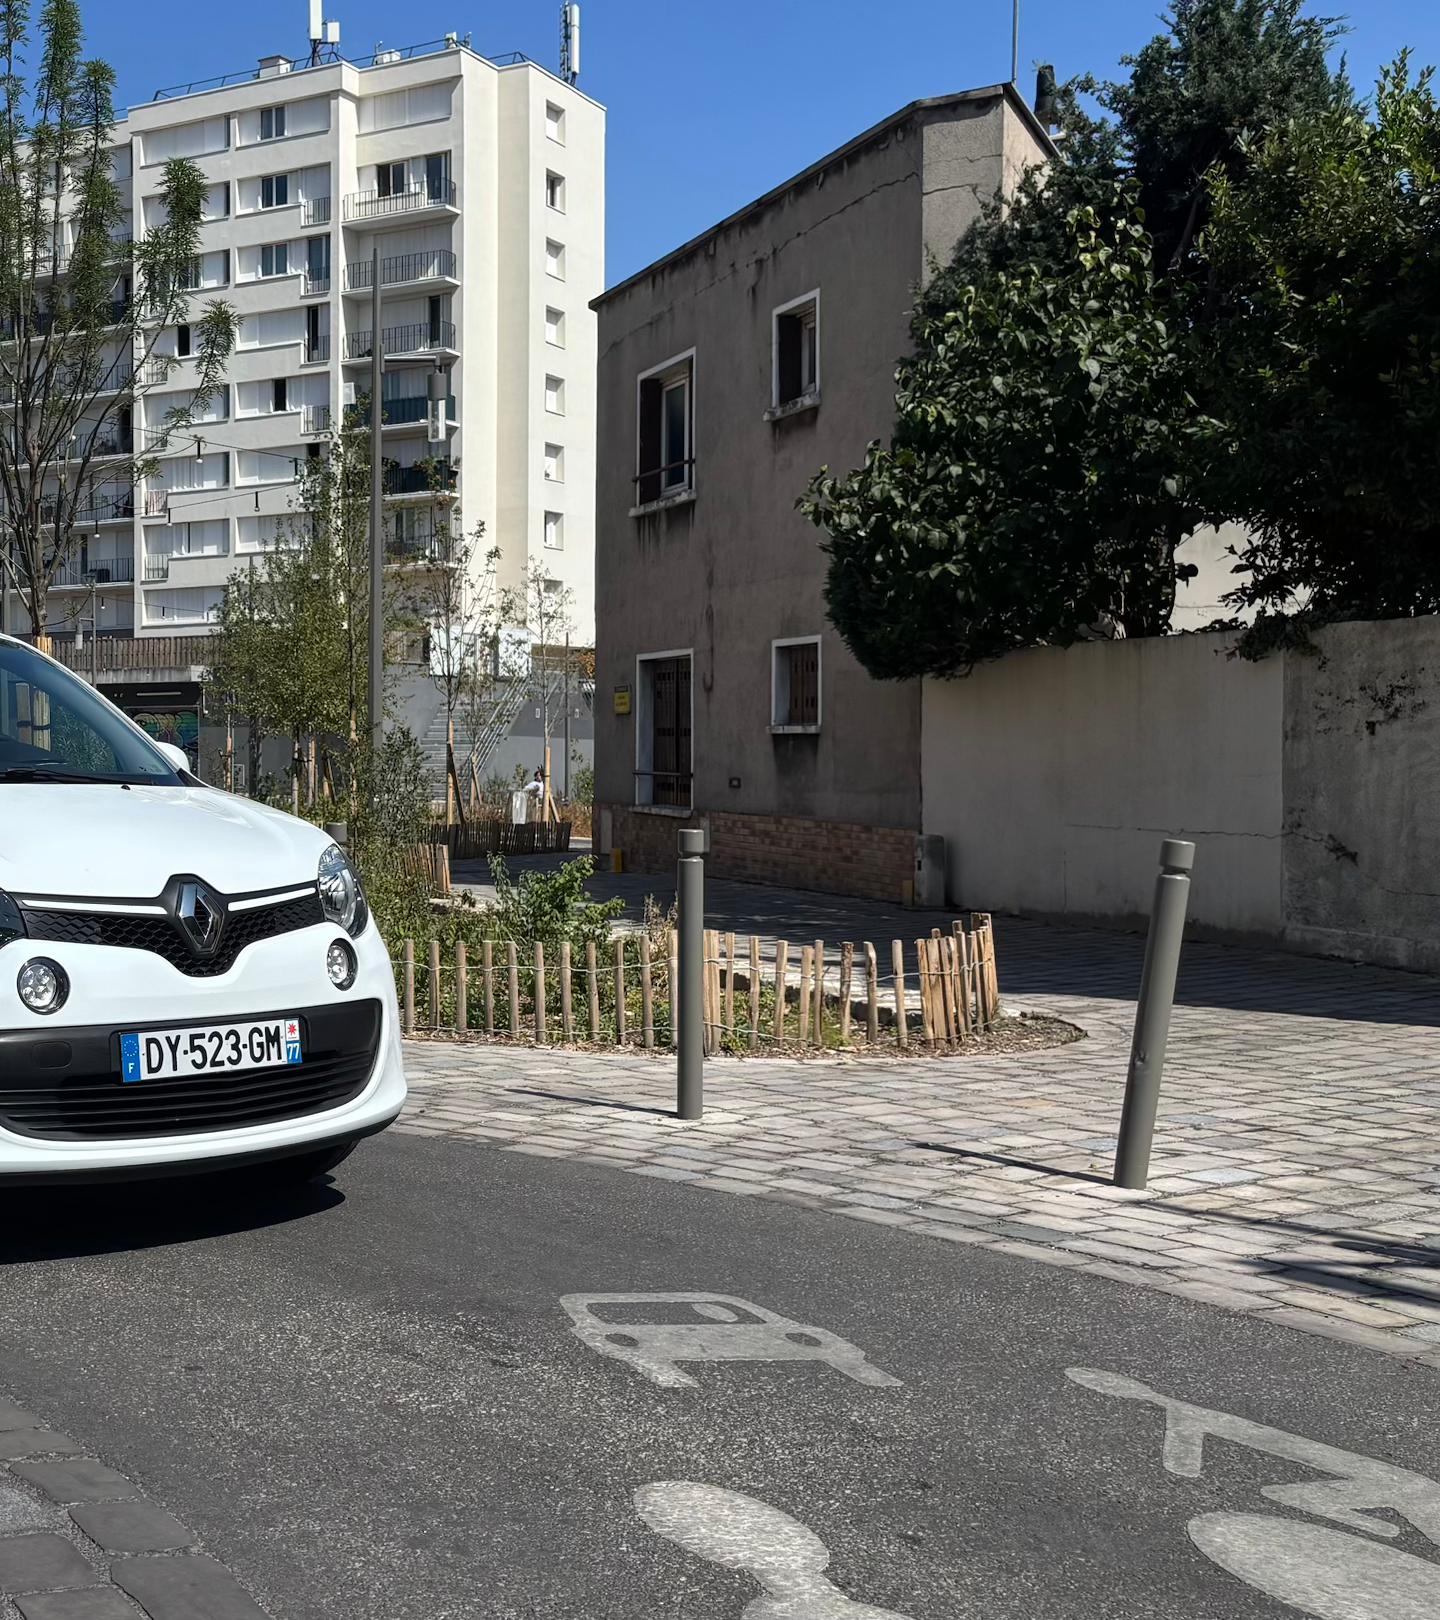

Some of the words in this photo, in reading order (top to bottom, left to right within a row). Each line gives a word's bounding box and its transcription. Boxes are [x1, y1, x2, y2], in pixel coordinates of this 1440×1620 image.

[145, 1025, 282, 1074] DY-523-GM
[287, 1042, 300, 1060] 77
[128, 1063, 135, 1073] F
